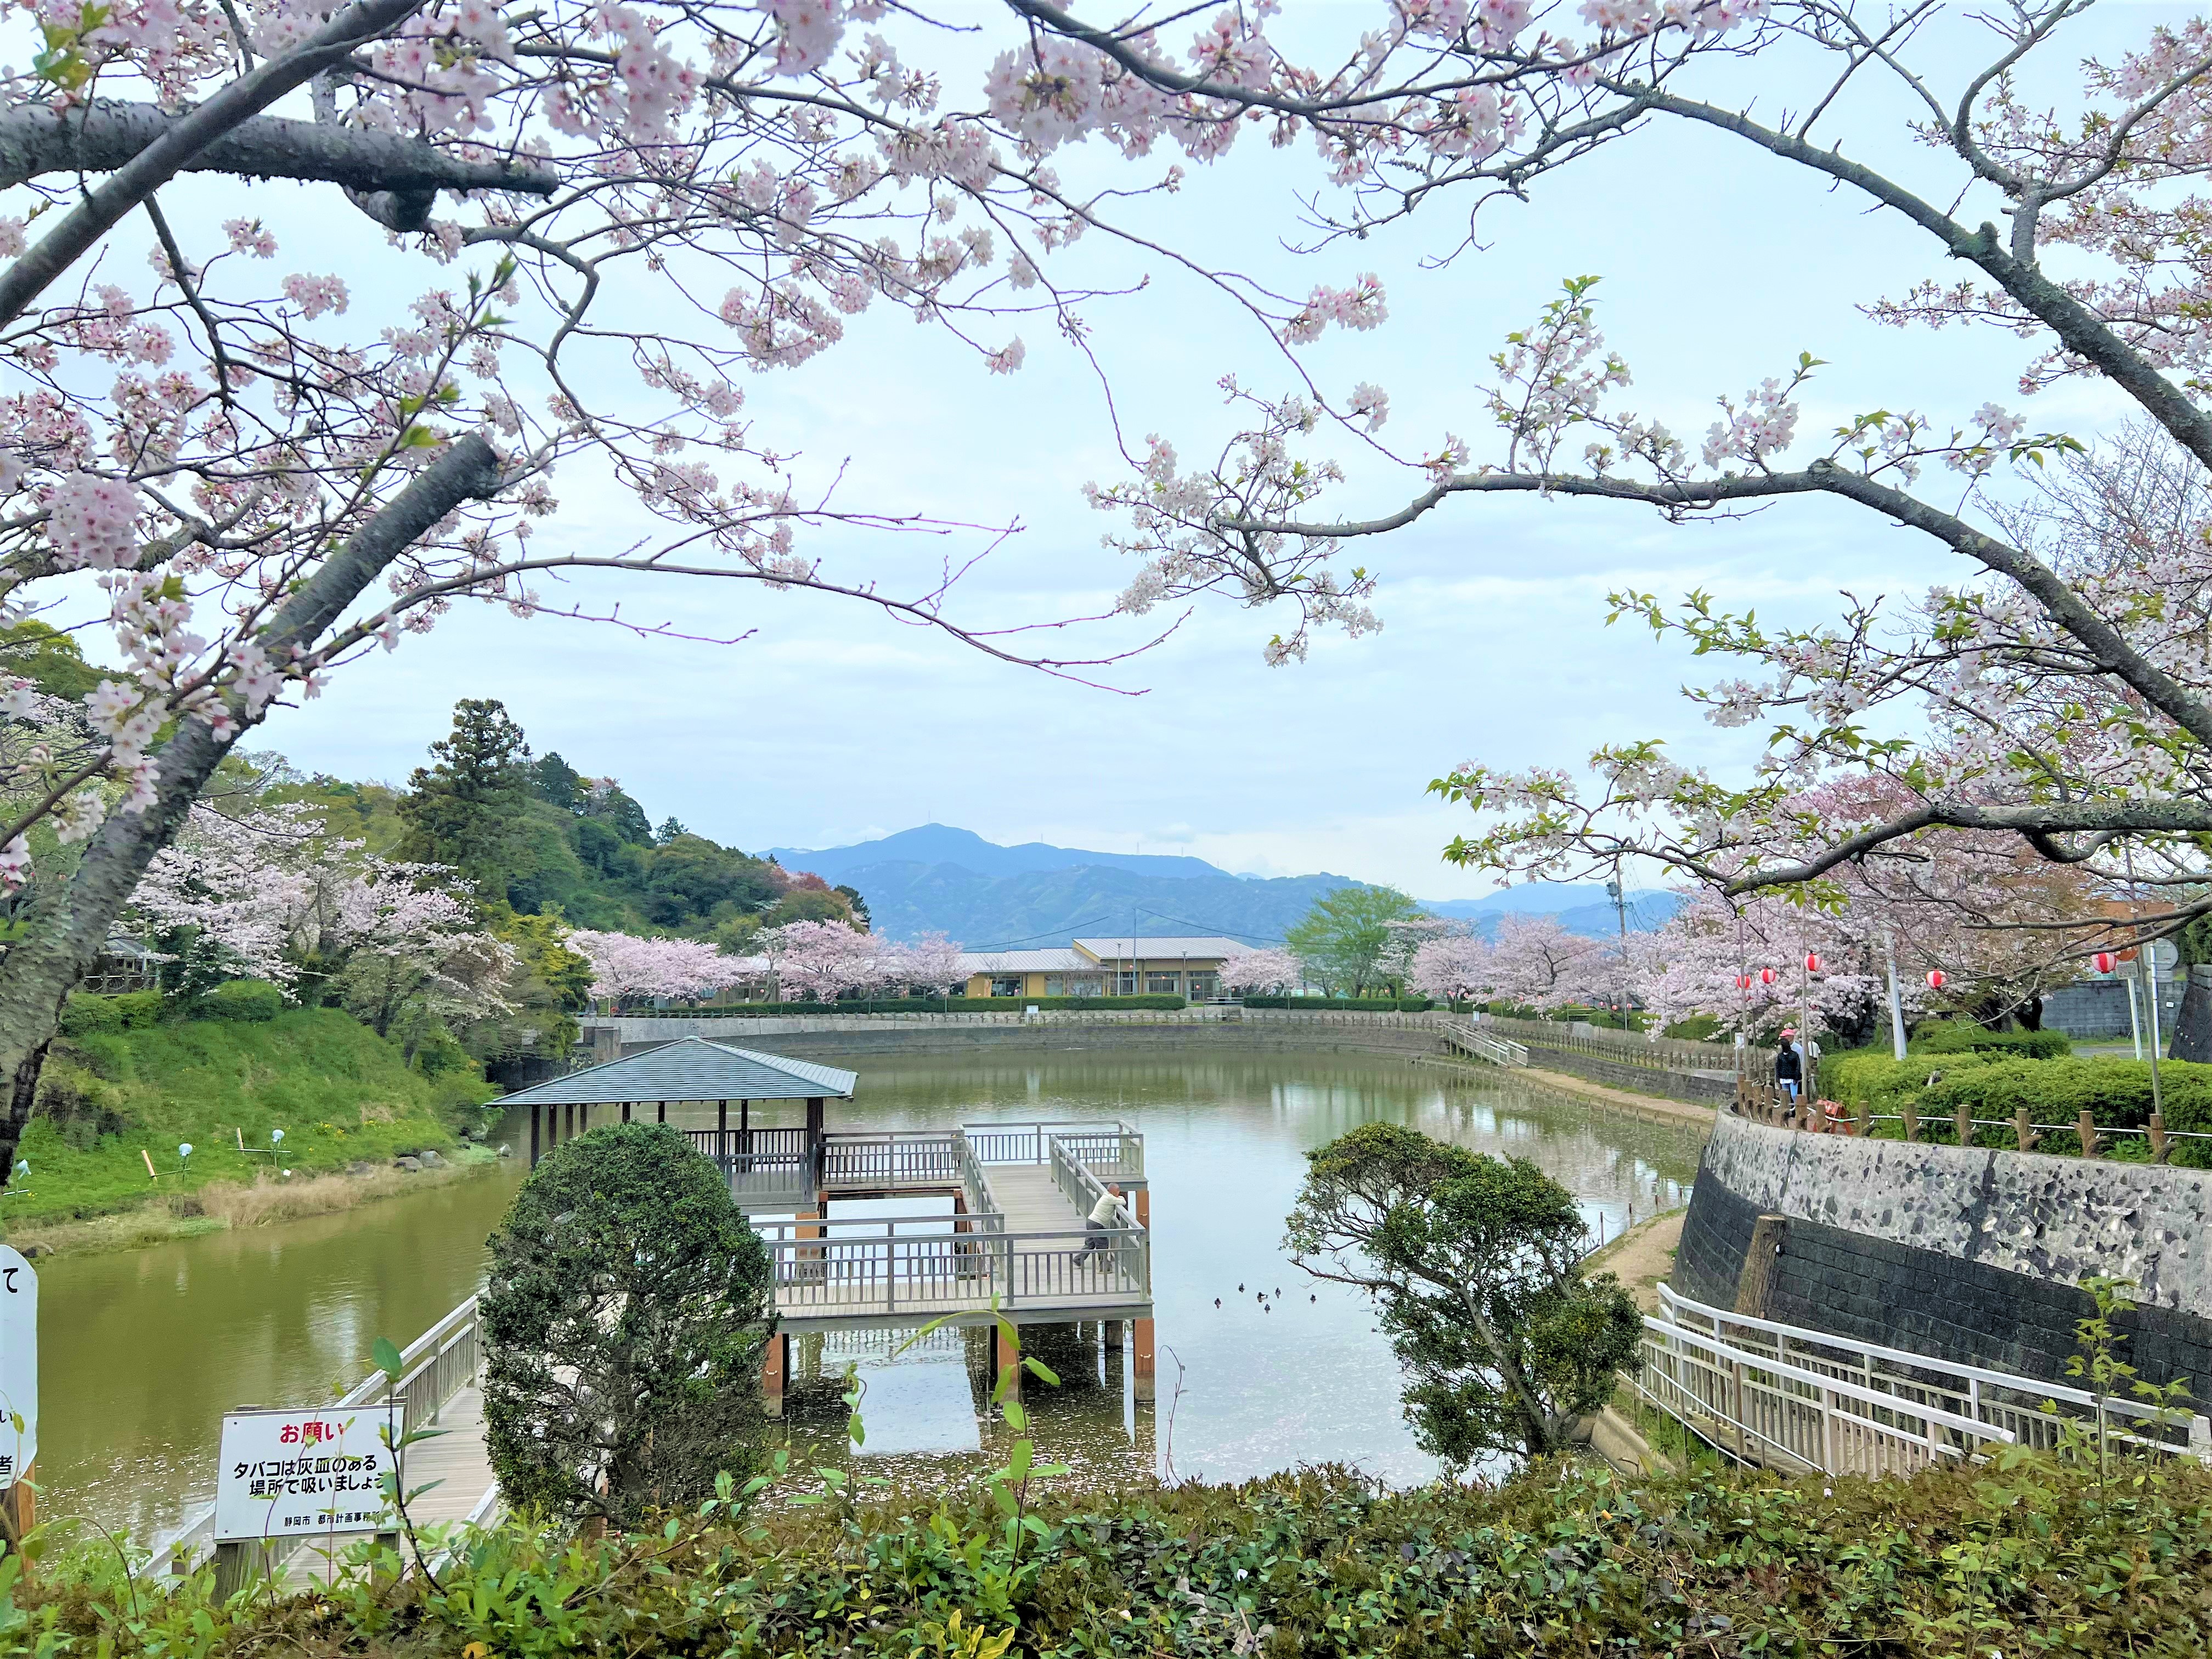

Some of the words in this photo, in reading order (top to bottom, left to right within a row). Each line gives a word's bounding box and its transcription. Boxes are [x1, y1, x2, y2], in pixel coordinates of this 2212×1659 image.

[280, 1422, 343, 1443] お願い
[234, 1455, 376, 1479] タバコは灰皿のある
